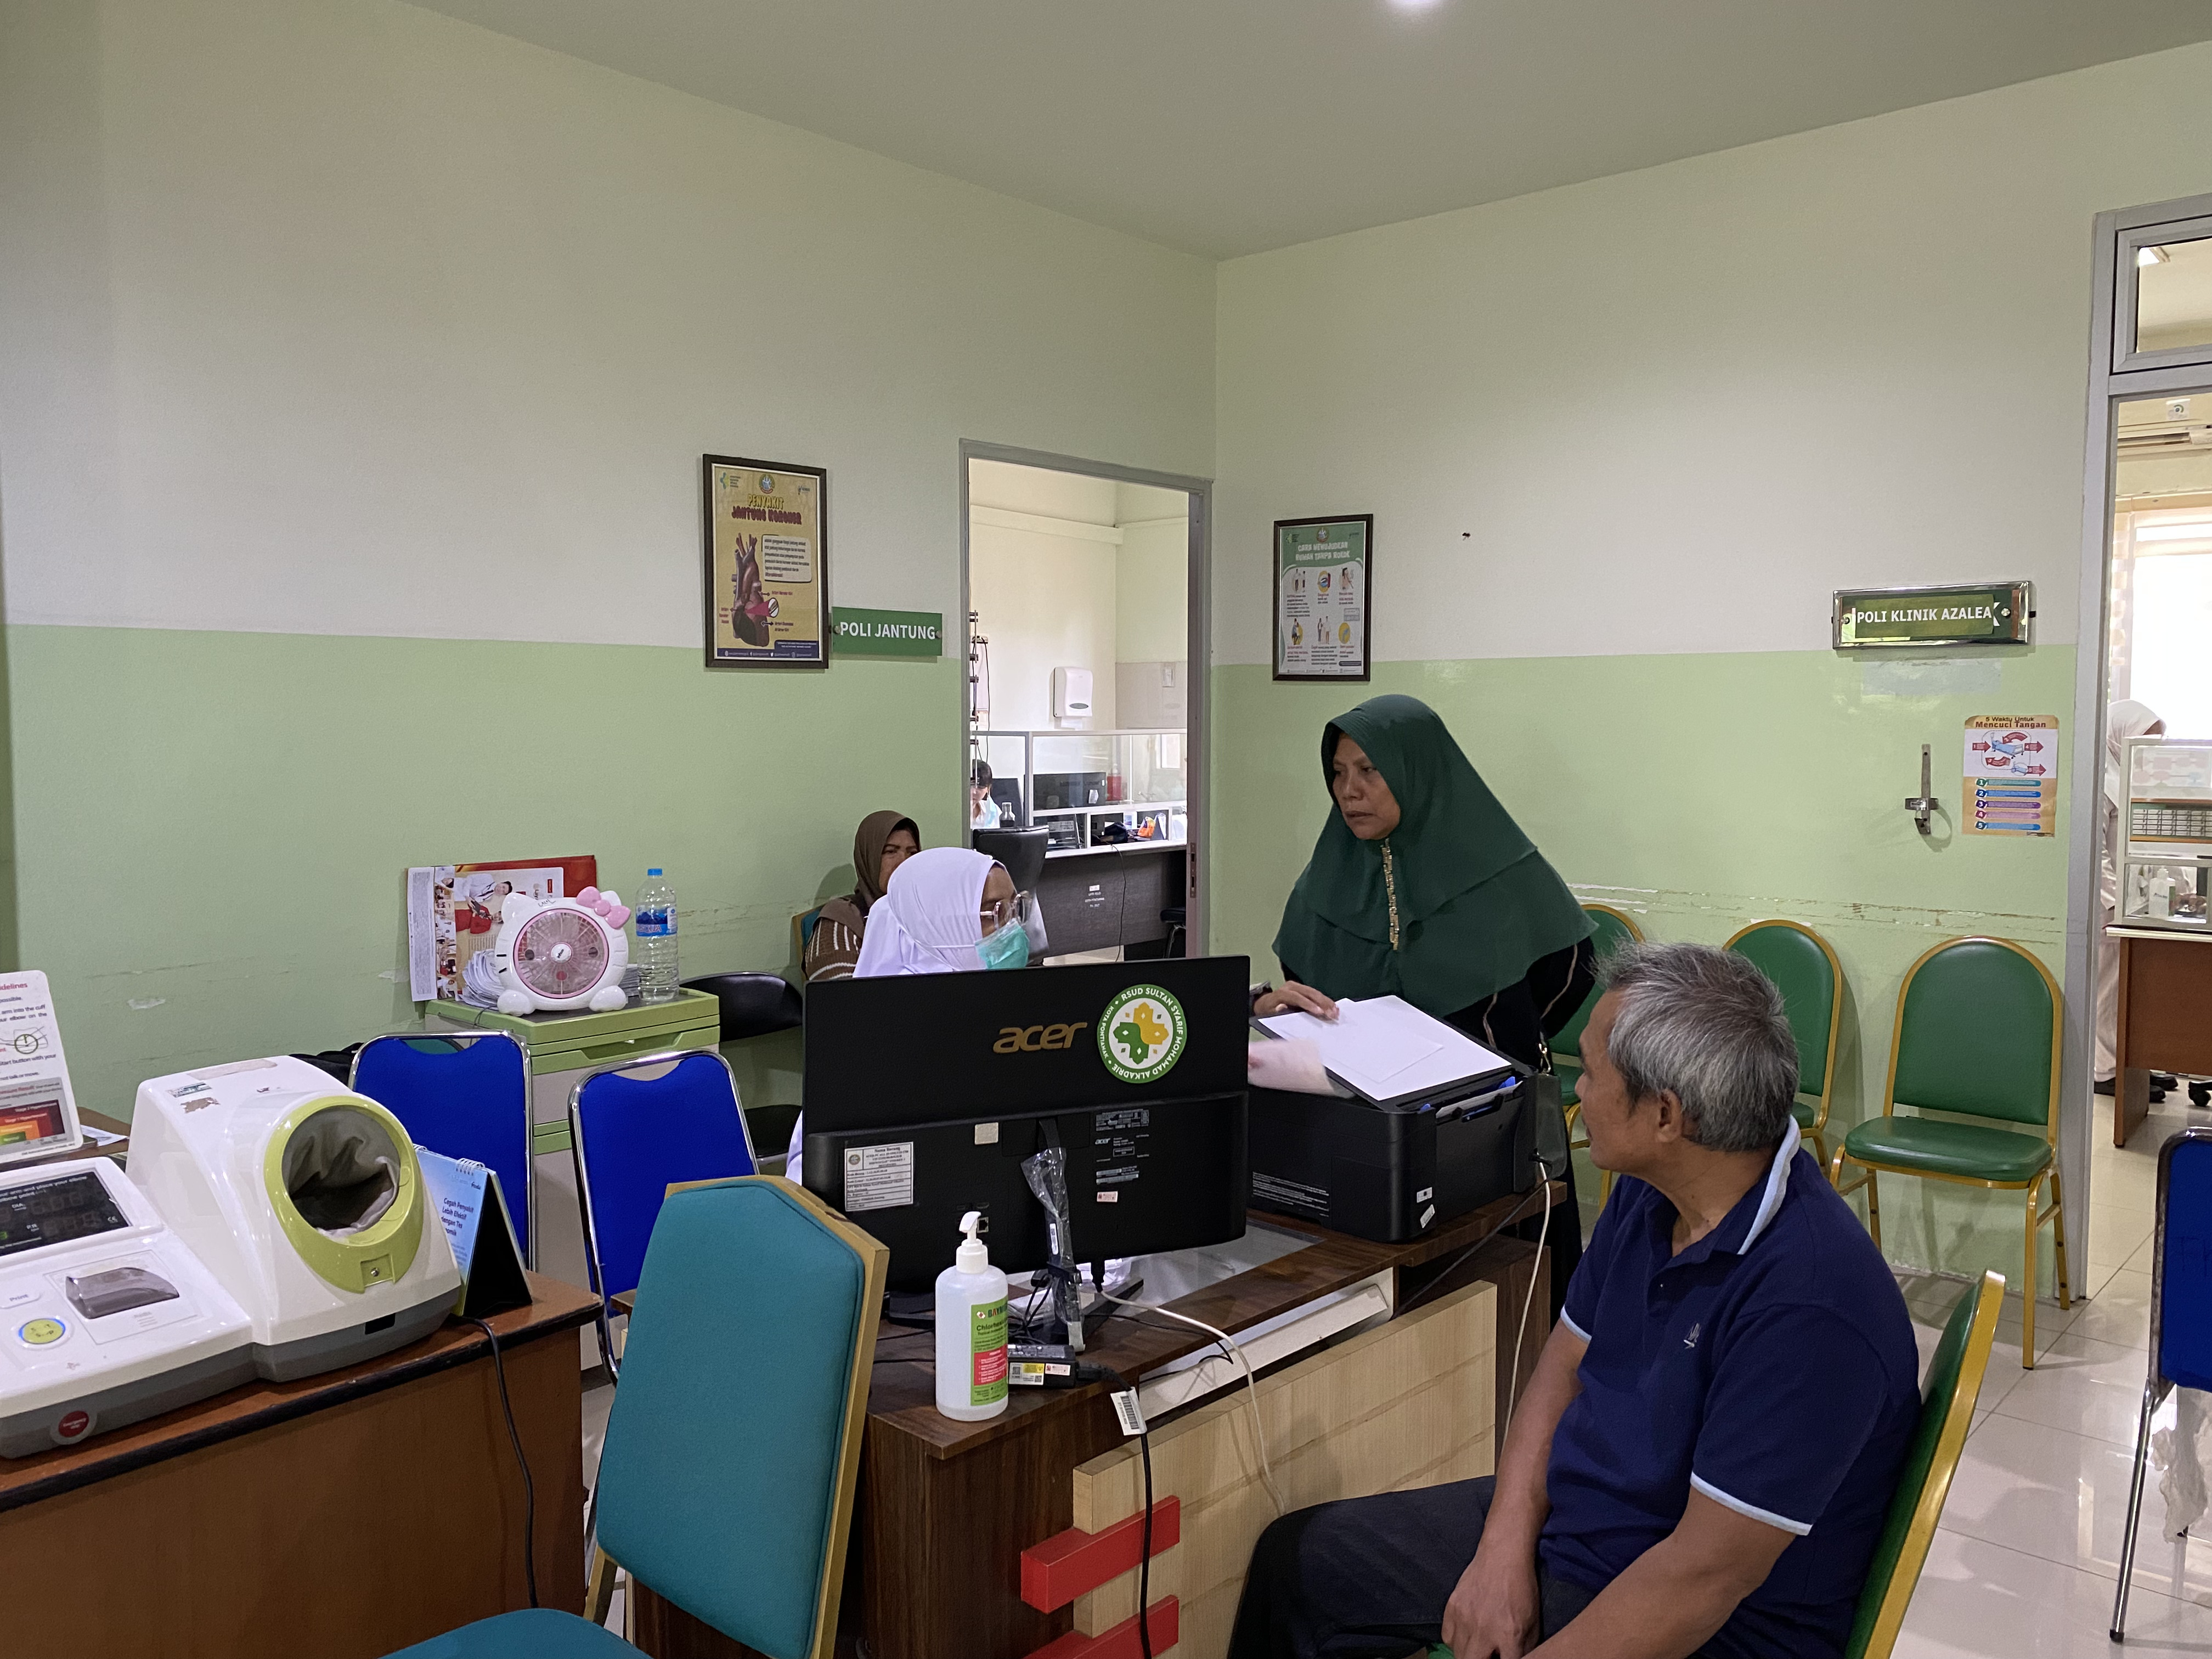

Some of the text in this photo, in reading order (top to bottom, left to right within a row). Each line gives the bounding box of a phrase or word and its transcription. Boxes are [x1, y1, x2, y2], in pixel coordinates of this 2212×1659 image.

[748, 494, 784, 510] PENYAKIT
[731, 505, 766, 521] JANTUNG
[1314, 552, 1332, 560] TANPA
[1333, 550, 1351, 558] ROKOK
[1857, 606, 1992, 623] POLI KLINIK AZALEA
[840, 622, 935, 640] POLI JANTUNG
[1121, 988, 1143, 1001] RSUD
[1146, 987, 1173, 1006] SULTAN
[1171, 1006, 1183, 1035] SYARIF
[992, 1022, 1088, 1054] acer
[1100, 1006, 1114, 1059] KOTA PONTIANAK
[1153, 1036, 1183, 1075] MOHAMAD
[1111, 1063, 1150, 1080] ALKADRIE
[442, 1207, 453, 1216] Lebih
[443, 1198, 474, 1213] Cegah Penyakit
[9, 1294, 29, 1302] Print
